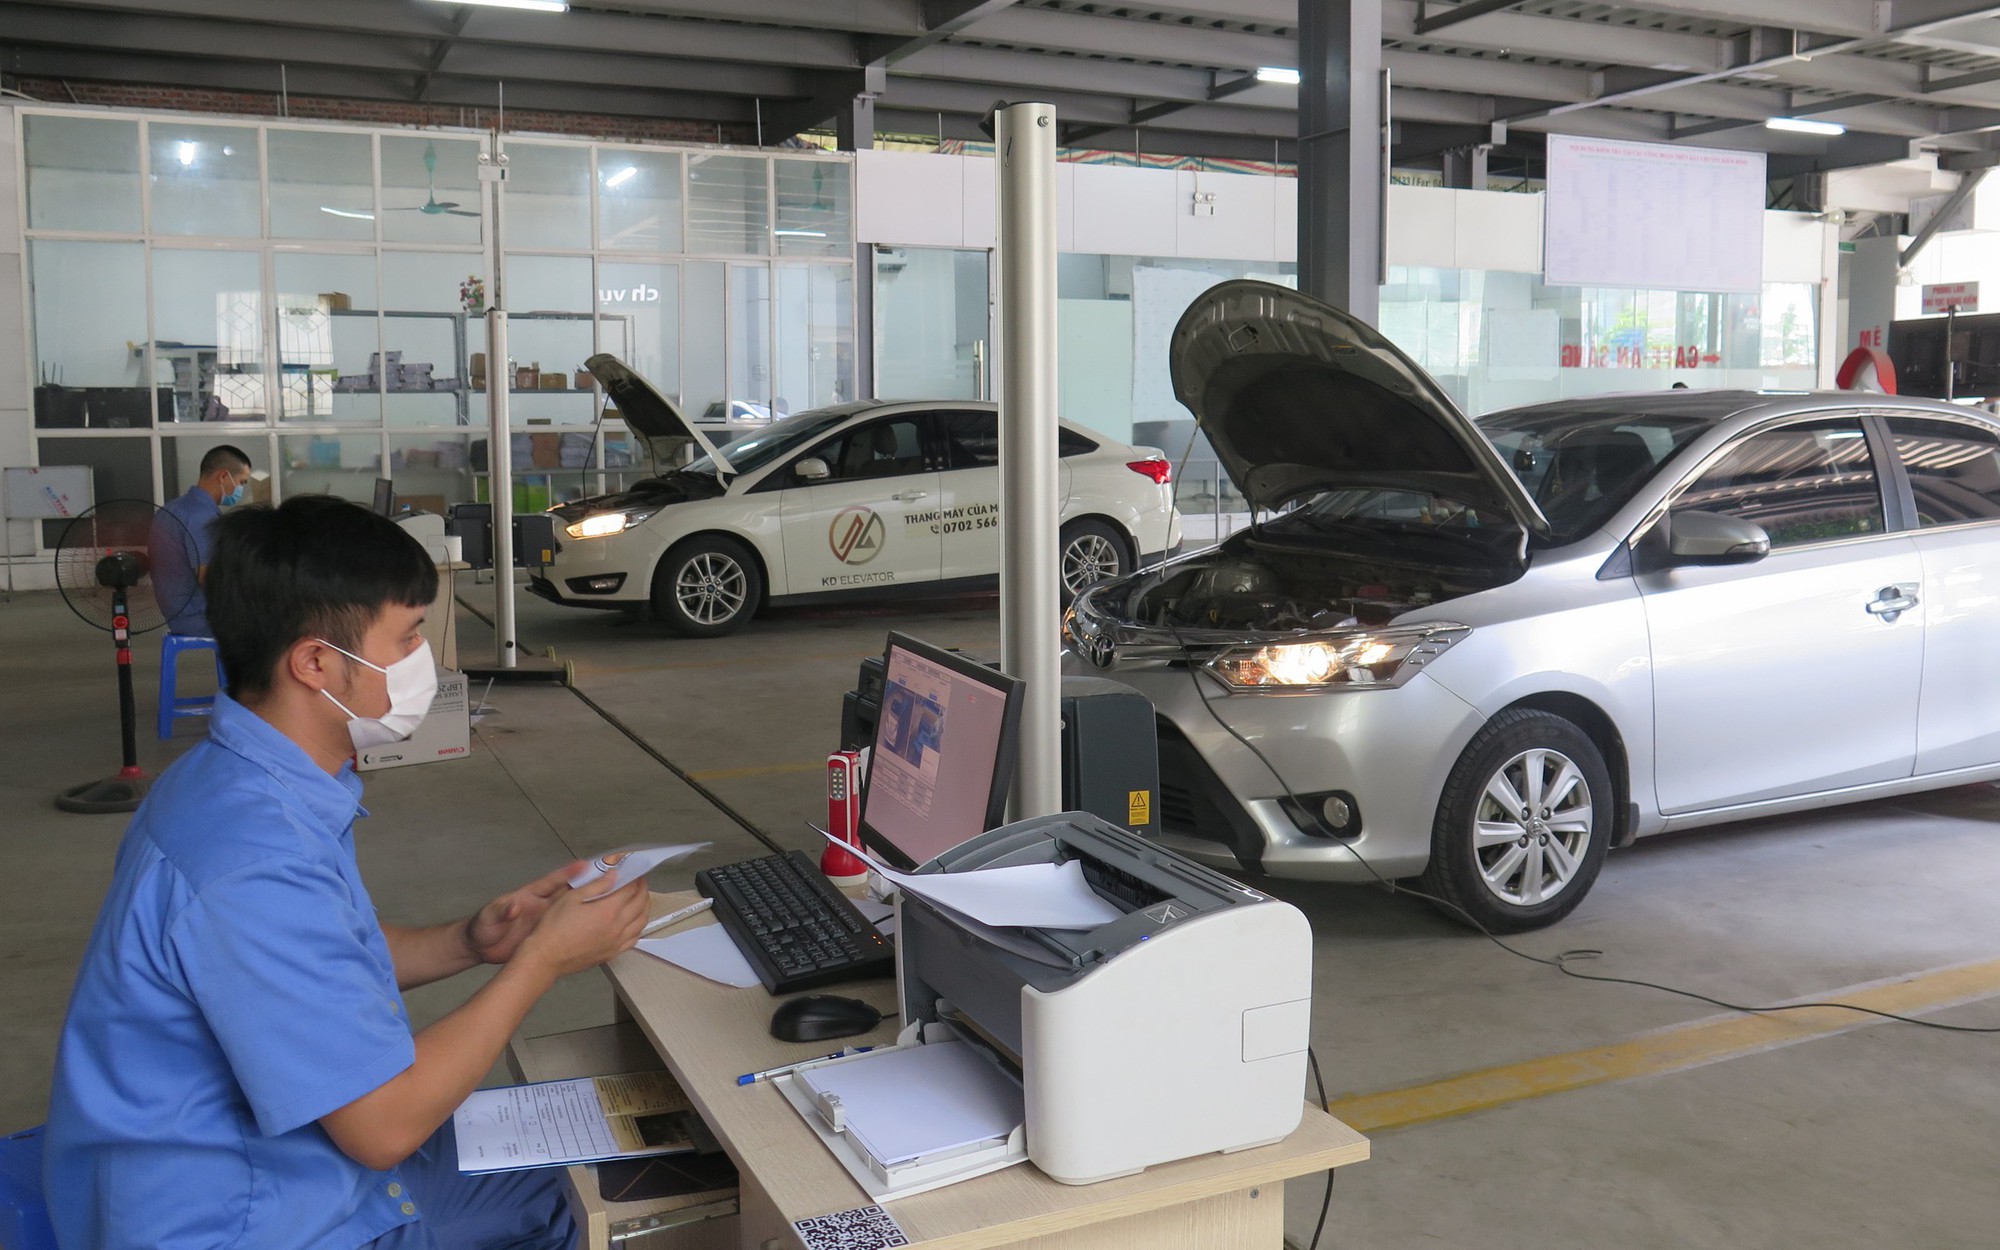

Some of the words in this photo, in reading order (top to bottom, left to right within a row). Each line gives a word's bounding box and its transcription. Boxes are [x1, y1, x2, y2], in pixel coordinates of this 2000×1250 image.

[905, 511, 941, 524] THANG
[967, 503, 987, 516] CỦA
[990, 503, 999, 513] M
[943, 520, 972, 533] 0702
[976, 516, 997, 529] 566
[822, 576, 837, 586] KD
[840, 571, 895, 585] ELEVATOR
[437, 746, 465, 756] Canon
